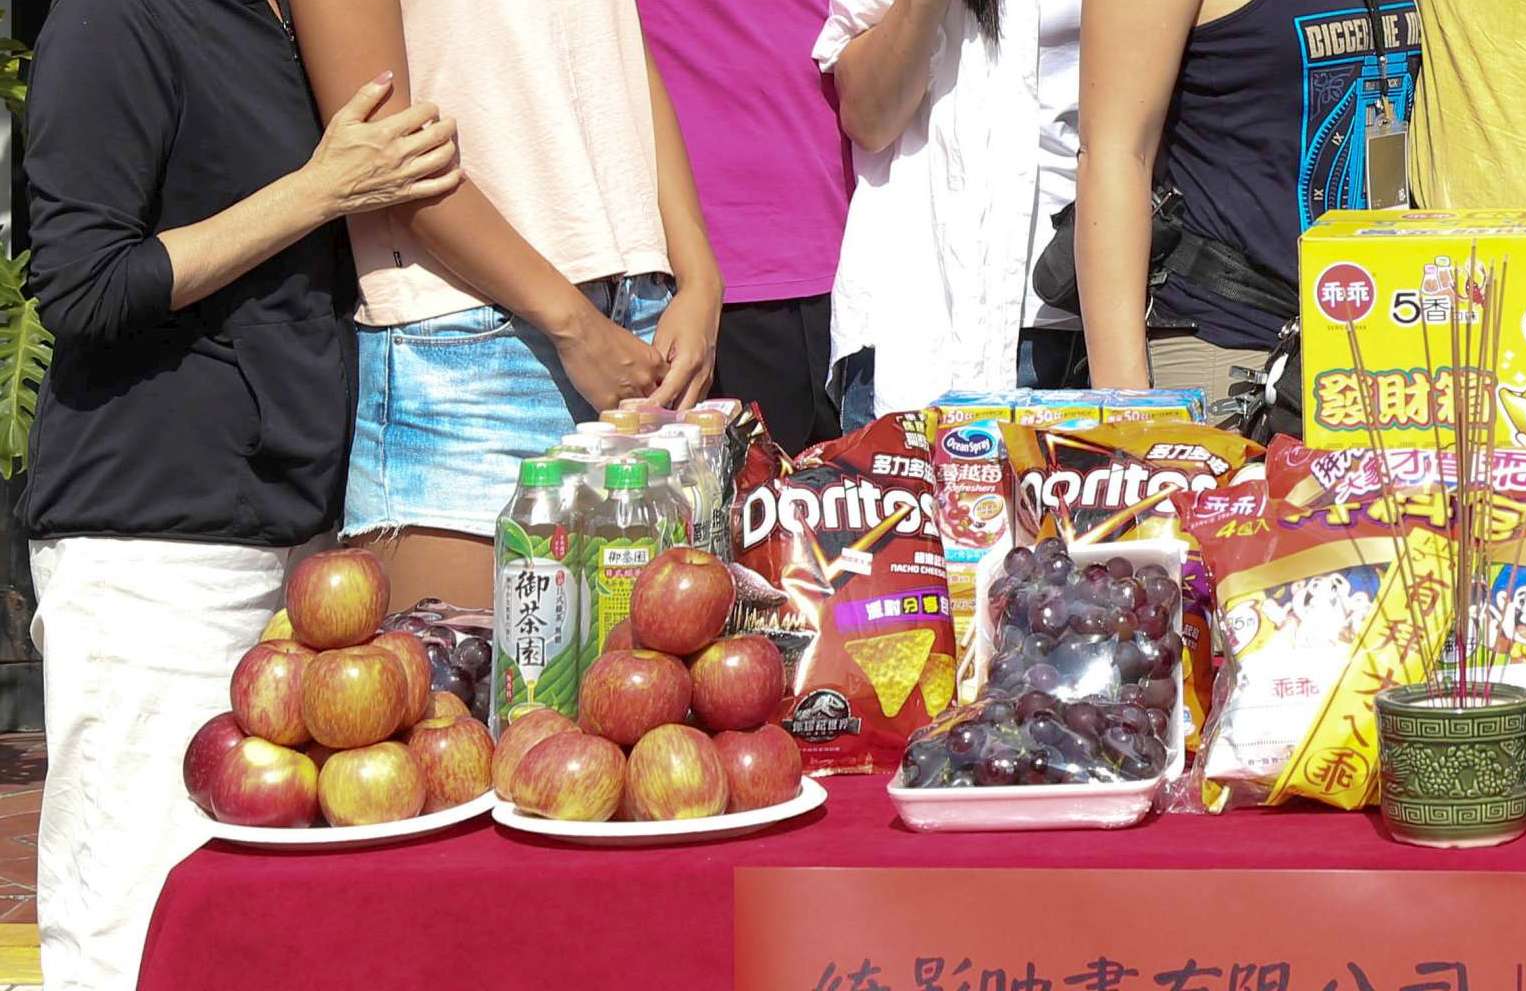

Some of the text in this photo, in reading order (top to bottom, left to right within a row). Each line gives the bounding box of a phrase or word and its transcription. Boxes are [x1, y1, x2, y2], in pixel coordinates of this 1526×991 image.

[1321, 281, 1370, 308] 乖乖
[1204, 495, 1256, 515] 乖乖
[514, 570, 550, 667] 御茶園
[1272, 676, 1321, 699] 乖乖
